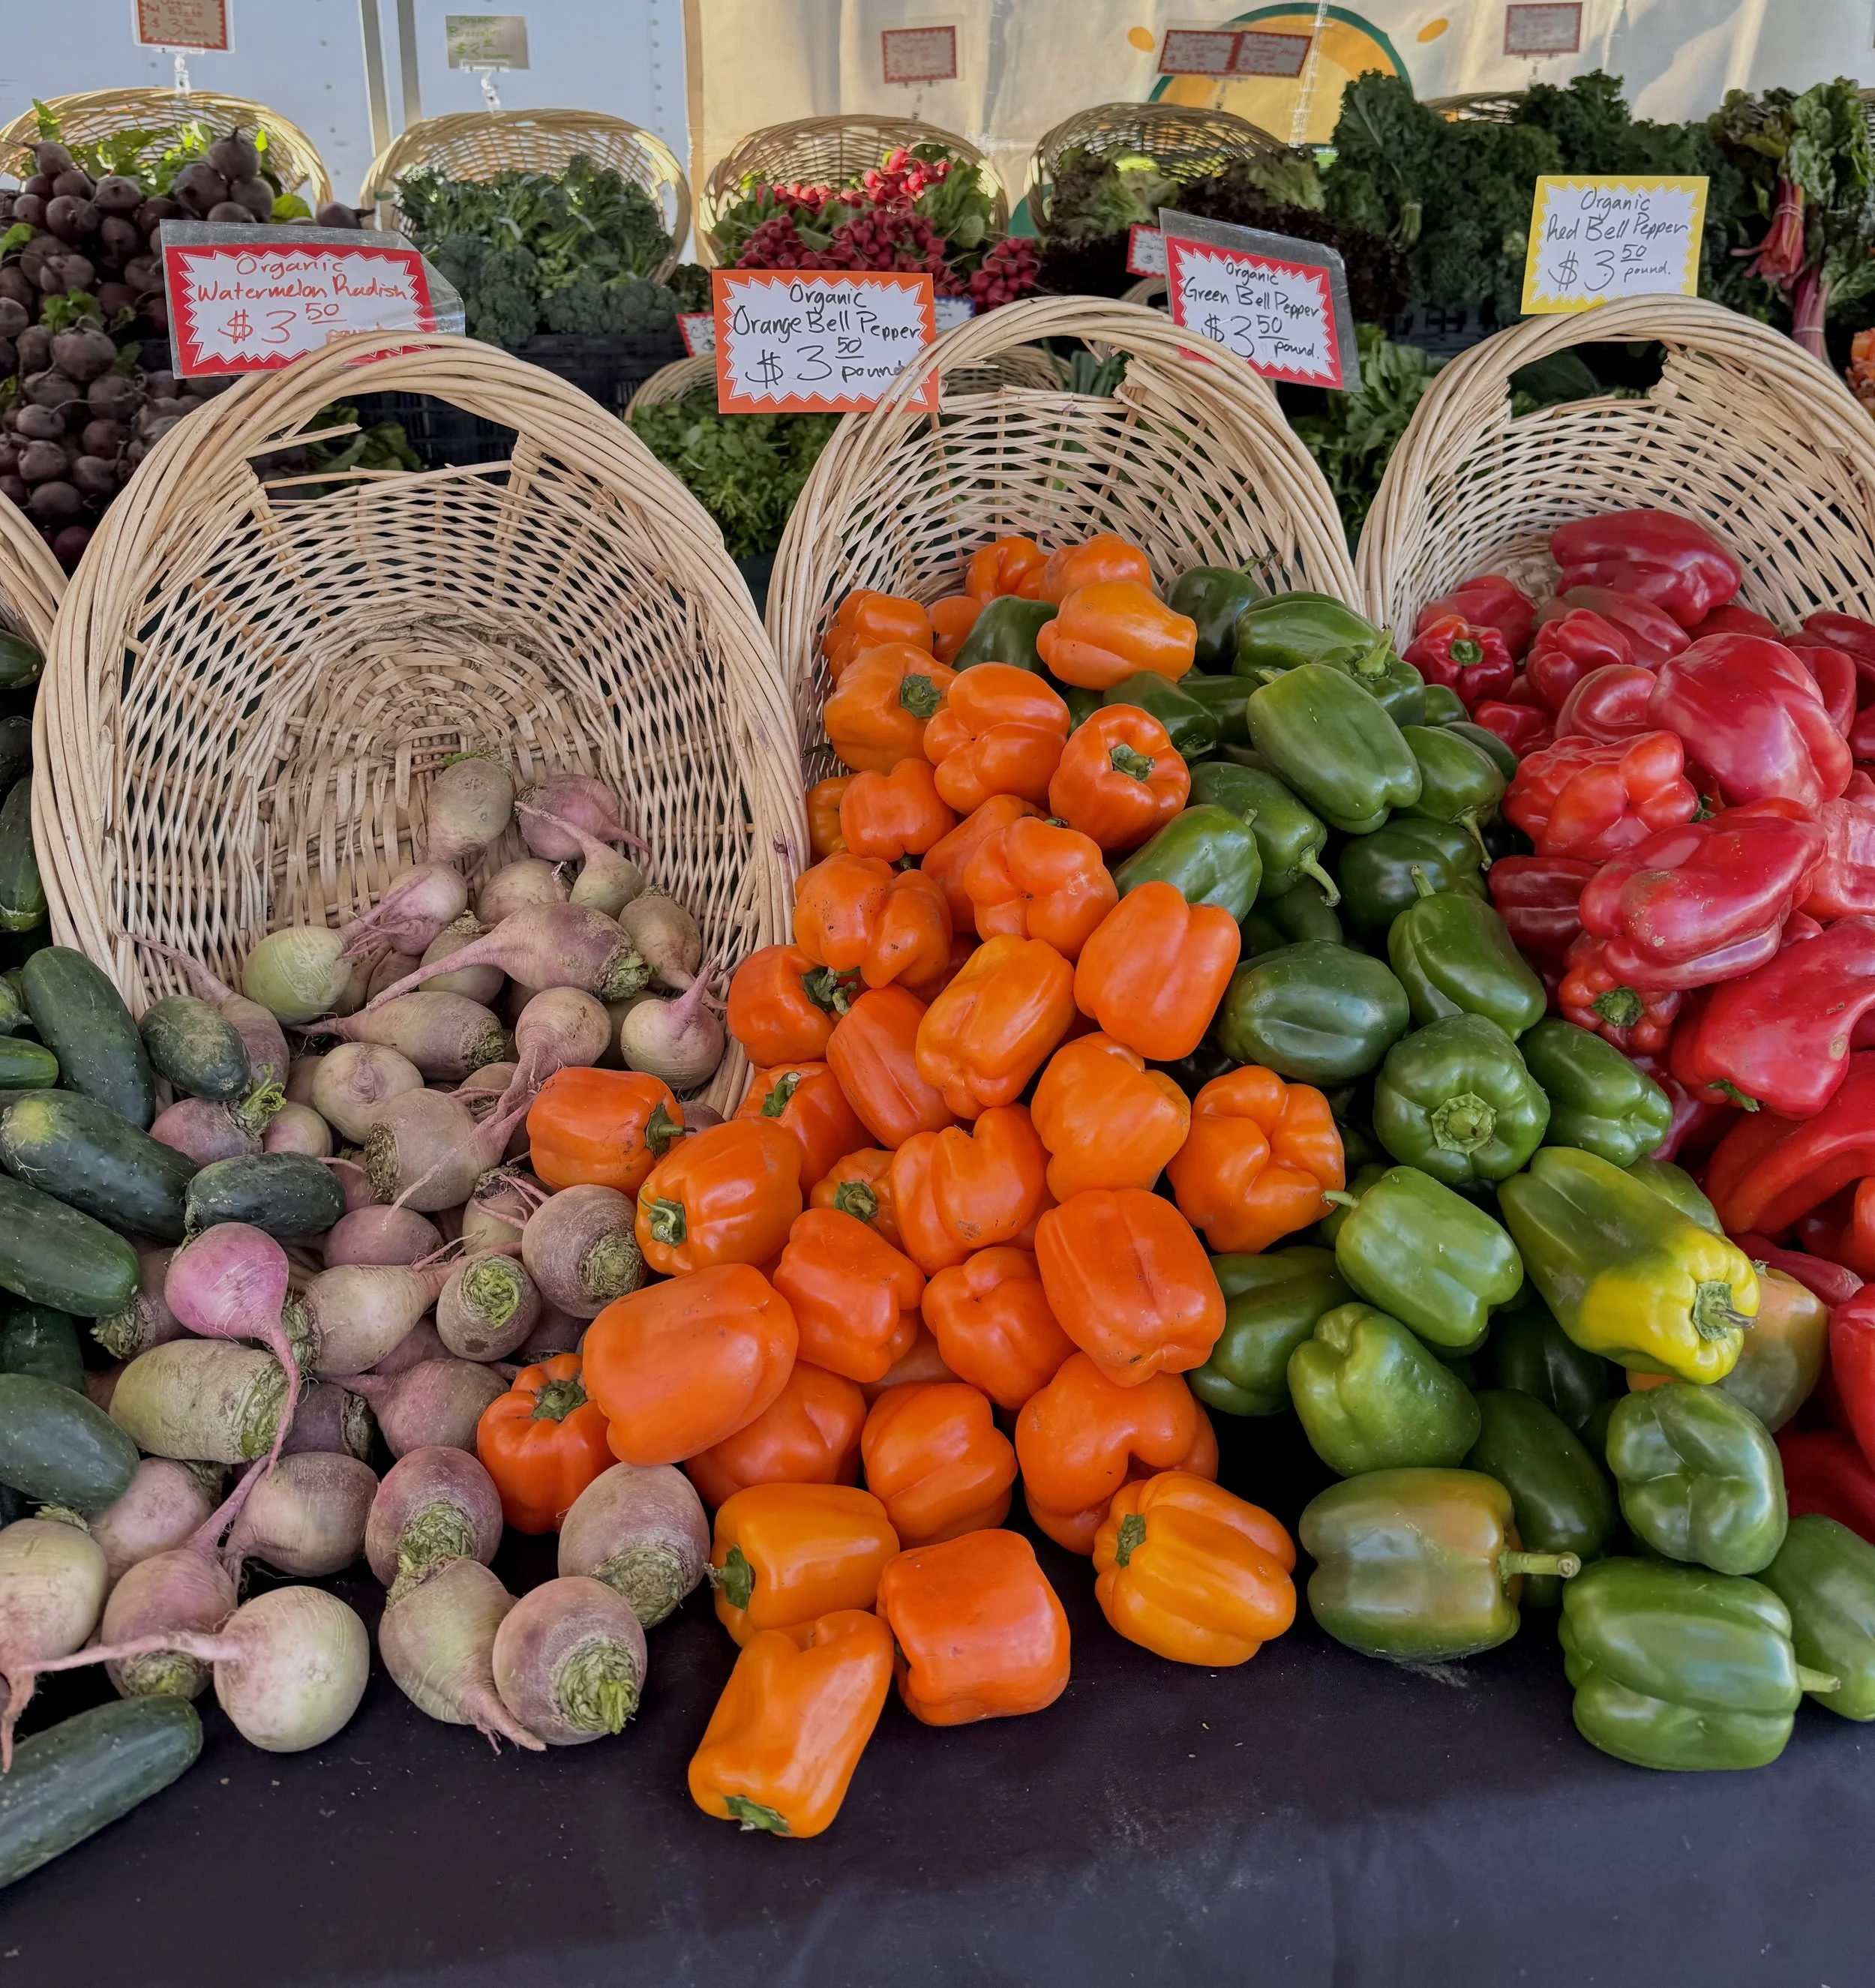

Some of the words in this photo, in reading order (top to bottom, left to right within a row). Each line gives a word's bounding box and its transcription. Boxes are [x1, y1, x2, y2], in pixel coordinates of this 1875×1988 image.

[1580, 187, 1650, 222] Organic
[1546, 214, 1580, 242] Red
[1586, 216, 1630, 241] Bell
[1633, 211, 1688, 240] Pepper
[236, 256, 344, 280] Organic
[1226, 262, 1279, 286] Organic
[197, 279, 328, 301] Watermelon
[332, 274, 408, 299] Radish
[790, 284, 867, 313] Organic
[1184, 277, 1229, 304] Green
[1236, 285, 1270, 310] Bell
[1274, 292, 1320, 320] Pepper
[733, 305, 802, 343] Orange
[808, 309, 850, 333] Bell
[860, 311, 921, 340] Pepper
